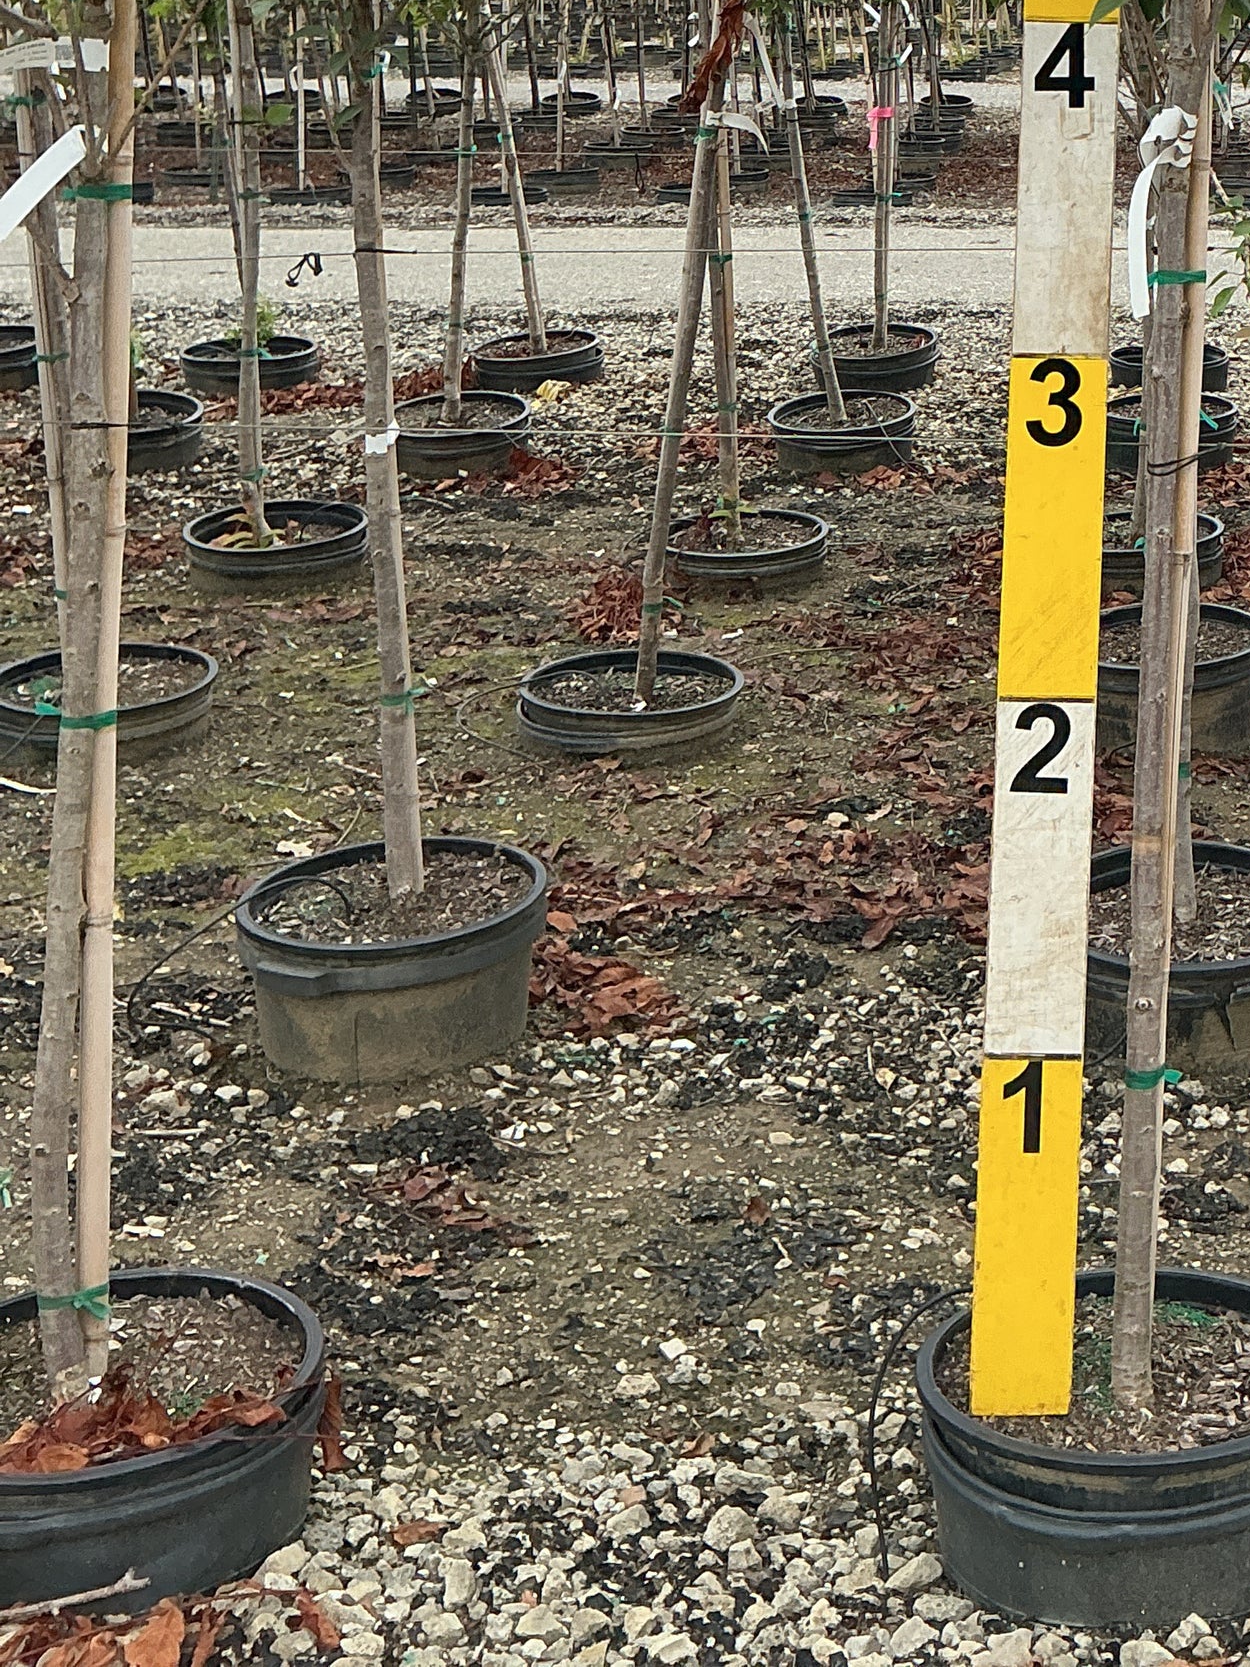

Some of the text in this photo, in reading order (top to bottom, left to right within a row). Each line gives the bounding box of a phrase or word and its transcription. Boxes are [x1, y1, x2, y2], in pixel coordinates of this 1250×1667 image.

[1034, 22, 1095, 109] 4
[1025, 358, 1083, 446] 3
[1009, 703, 1071, 794] 2
[1002, 1061, 1043, 1154] 1
